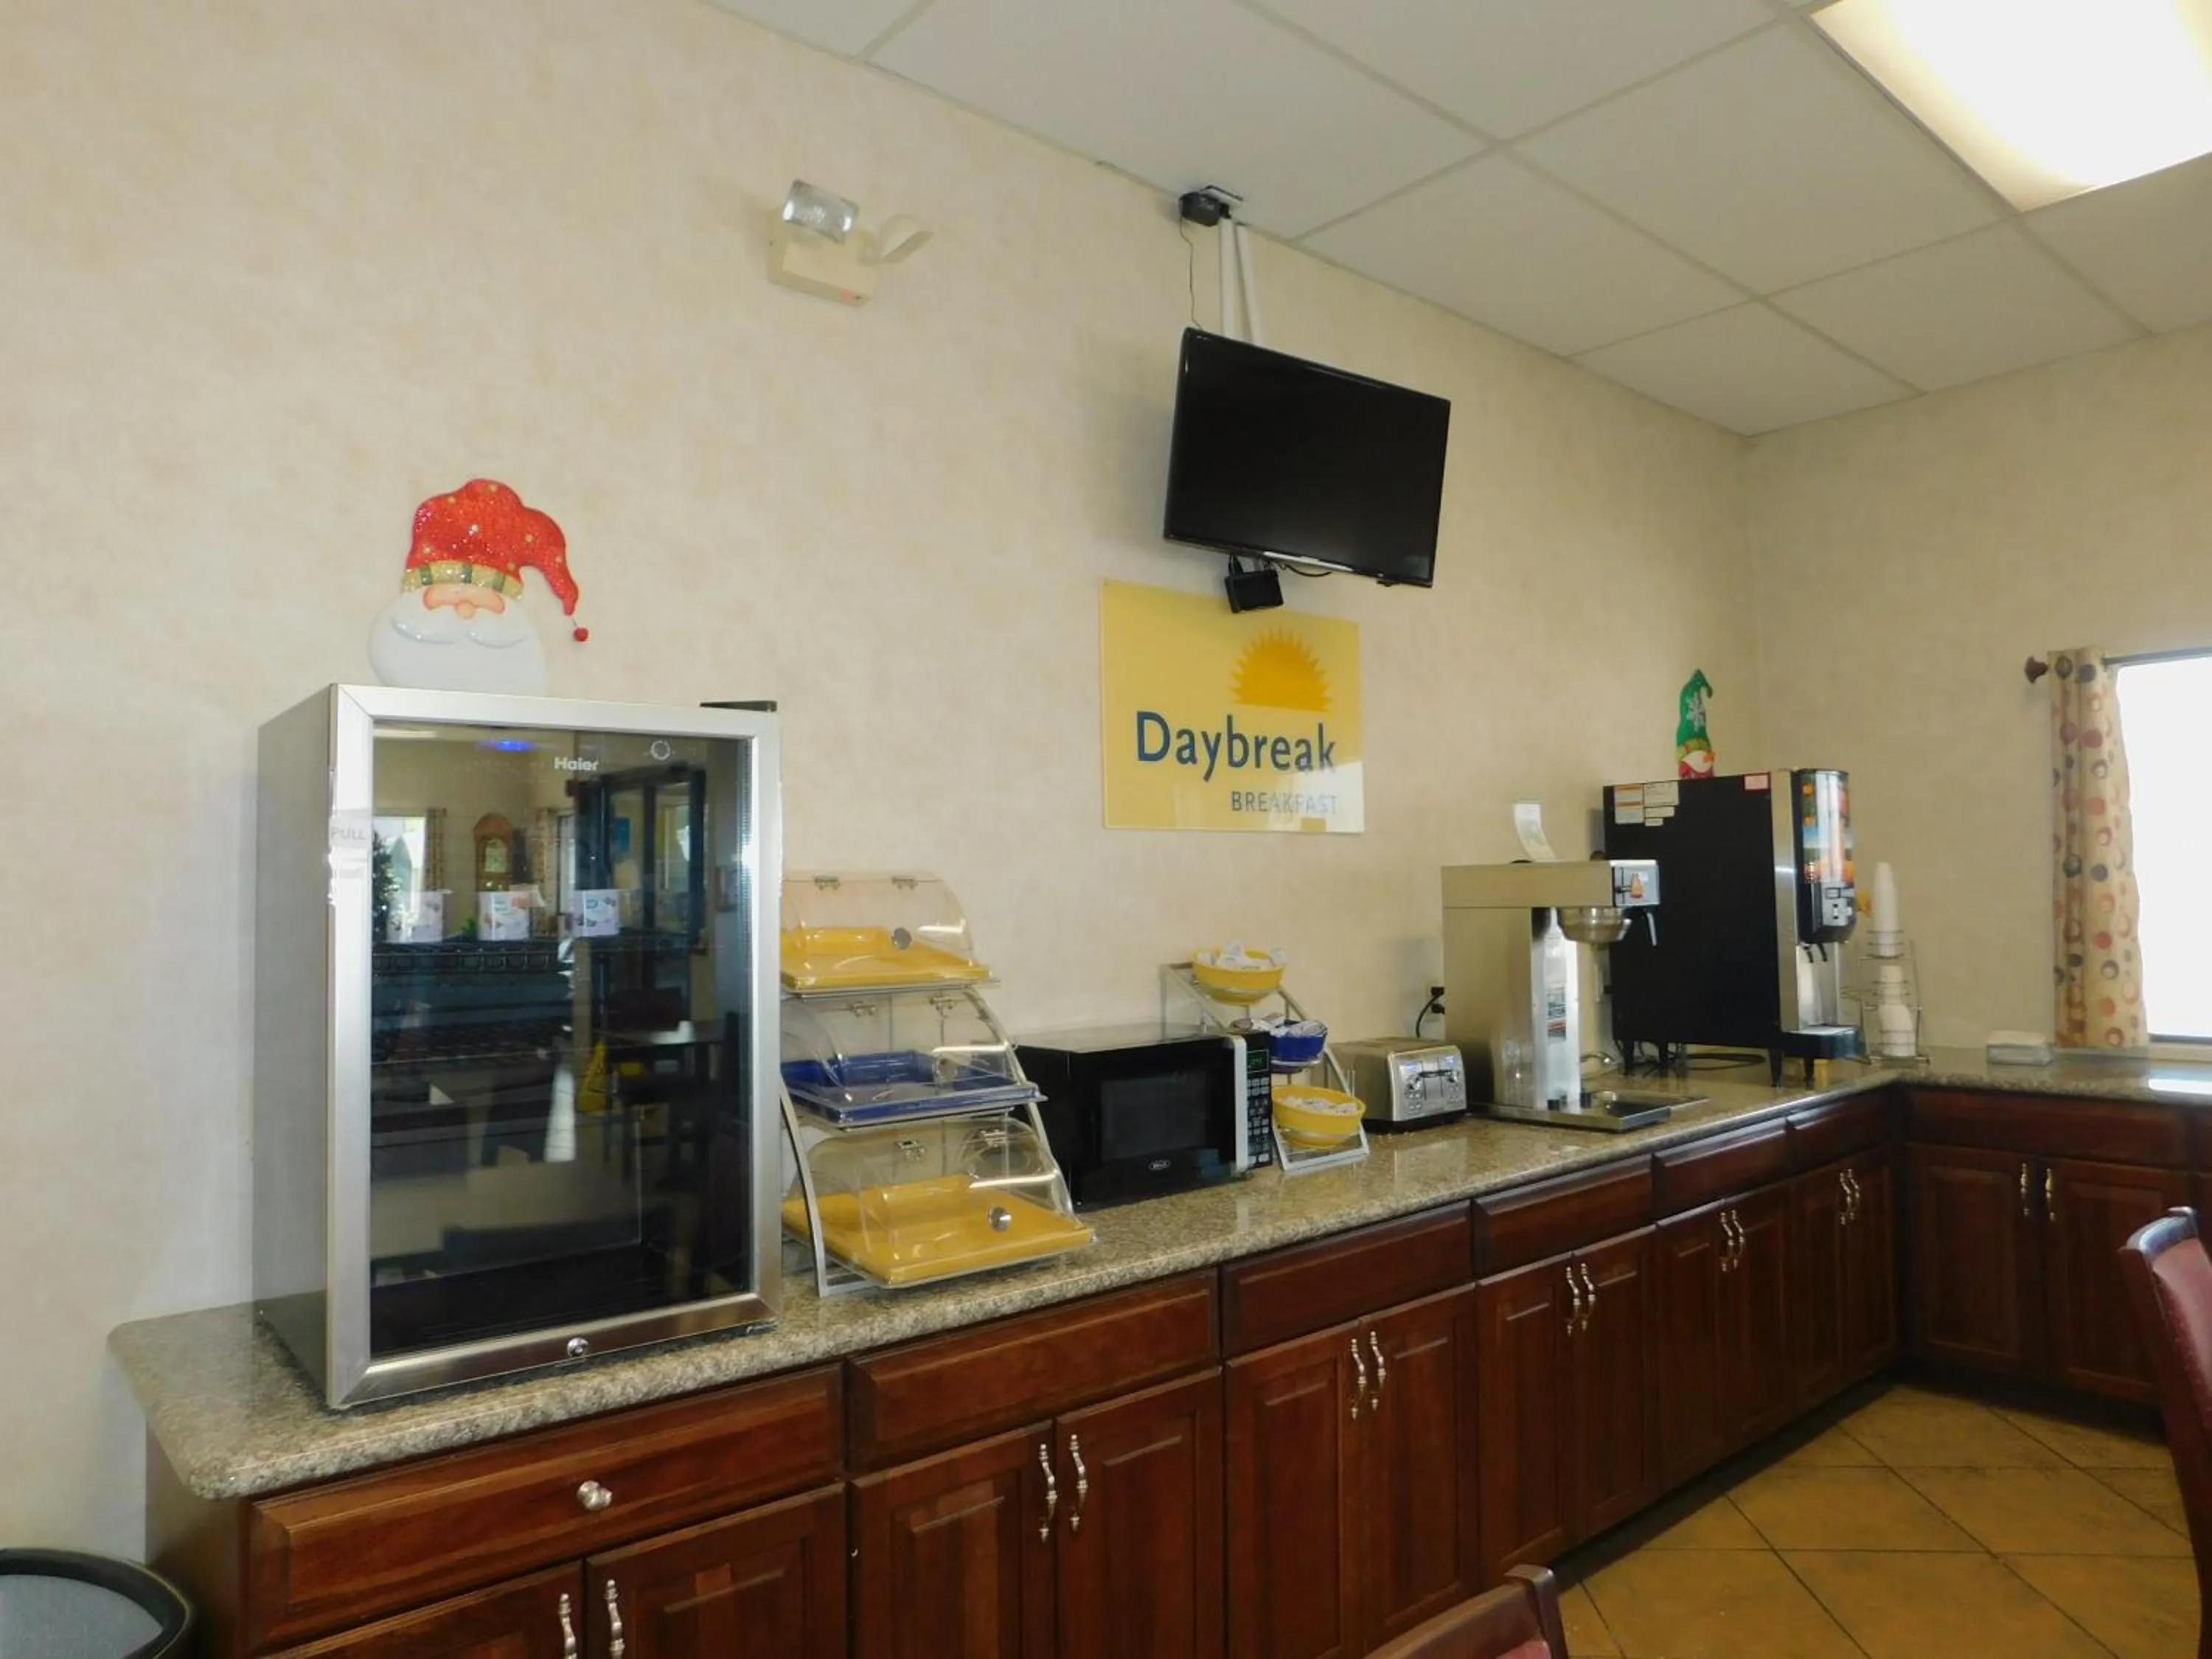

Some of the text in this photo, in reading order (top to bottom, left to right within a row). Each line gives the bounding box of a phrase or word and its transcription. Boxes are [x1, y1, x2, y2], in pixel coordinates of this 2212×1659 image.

[1135, 710, 1336, 782] Daybreak
[554, 757, 599, 771] Haier
[1231, 790, 1339, 815] BREAKFAST
[330, 826, 366, 840] PULL
